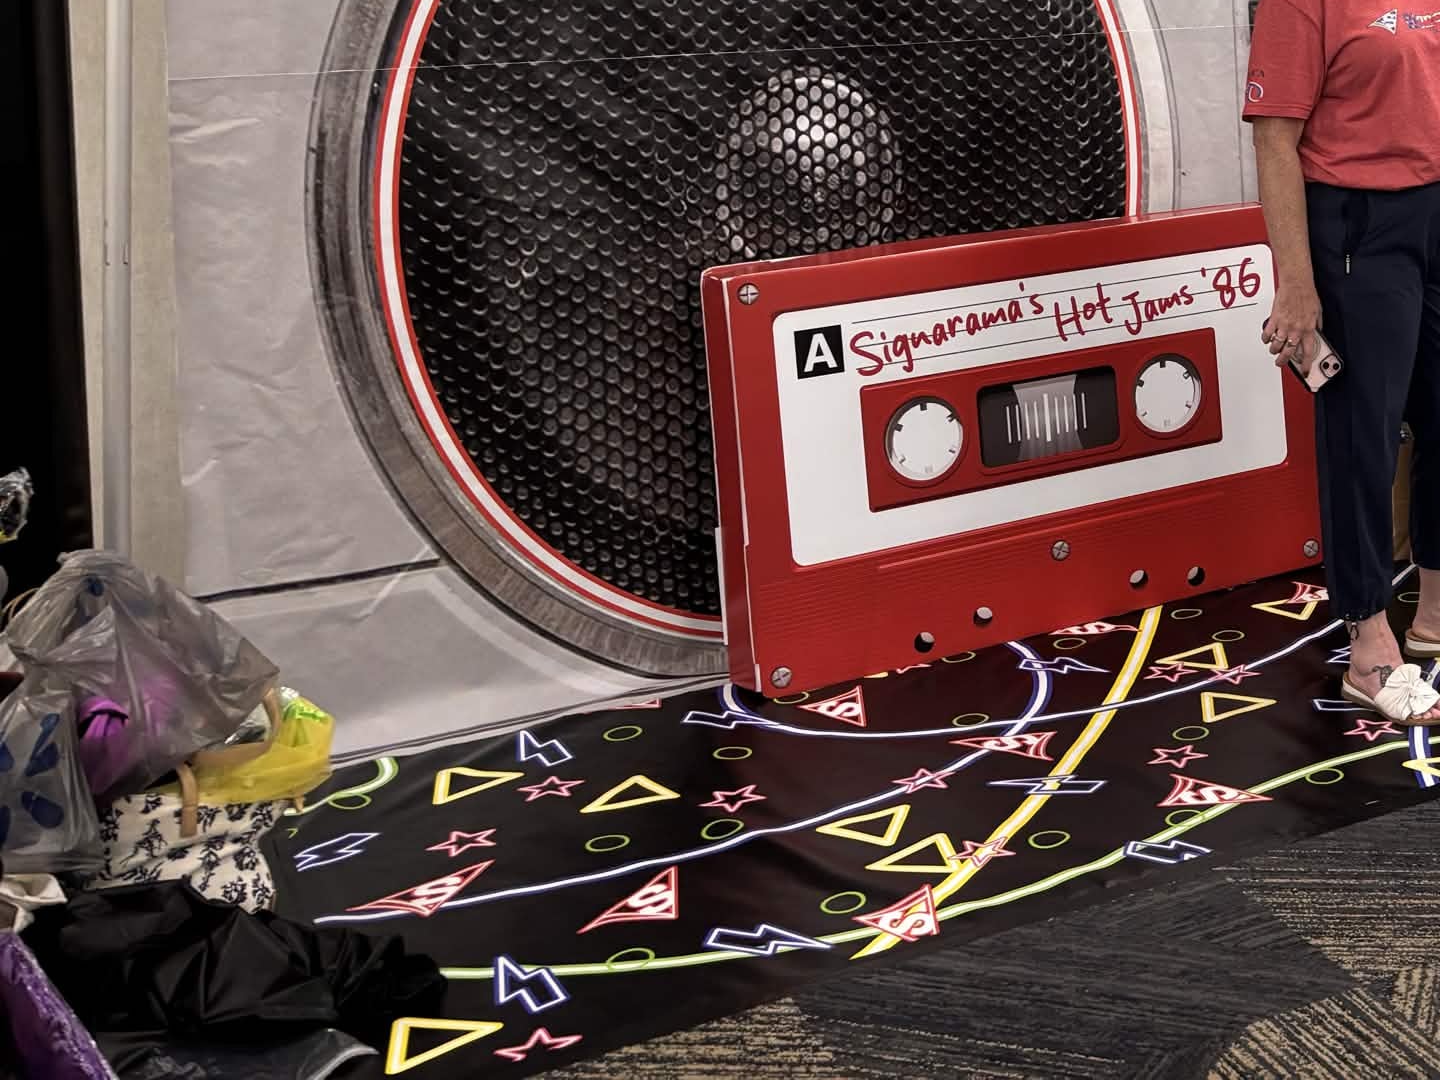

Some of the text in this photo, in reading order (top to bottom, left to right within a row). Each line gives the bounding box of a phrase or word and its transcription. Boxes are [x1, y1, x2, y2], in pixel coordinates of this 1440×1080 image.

[803, 333, 837, 372] A
[850, 257, 1260, 376] Signarama's Hot Jams '86
